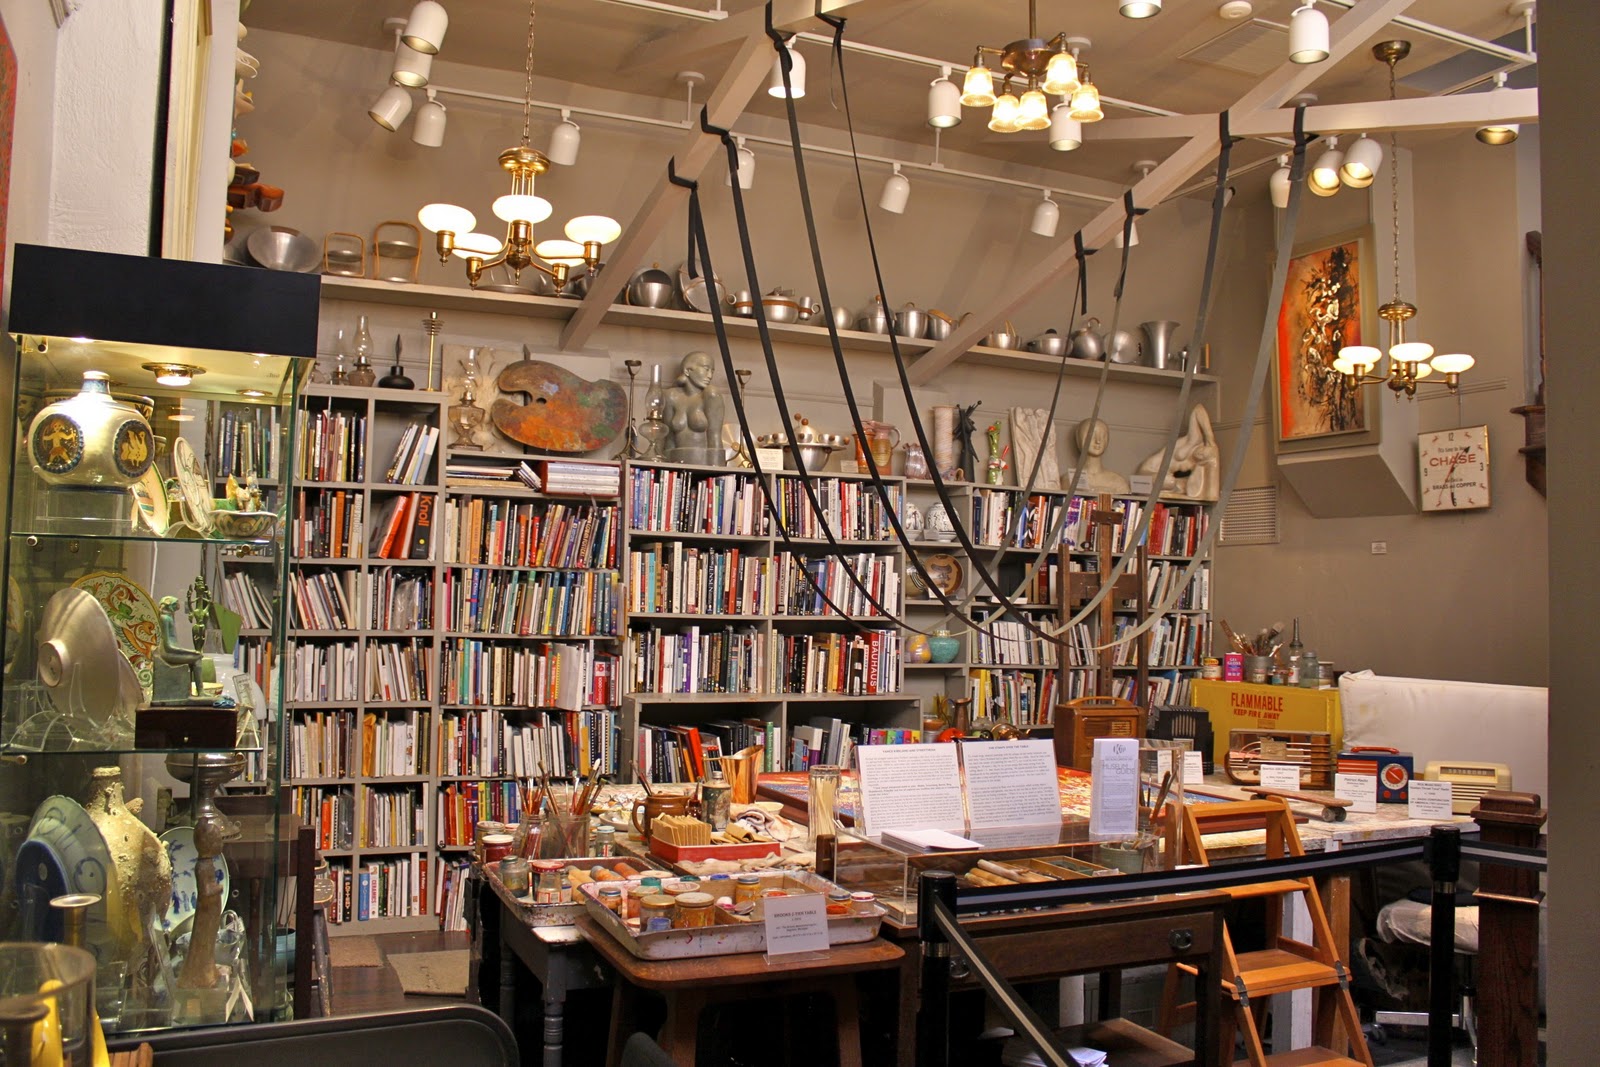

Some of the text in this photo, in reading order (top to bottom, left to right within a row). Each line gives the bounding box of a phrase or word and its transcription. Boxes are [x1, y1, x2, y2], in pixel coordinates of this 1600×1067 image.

[1448, 432, 1454, 442] 12
[1429, 453, 1477, 467] CHASE
[1480, 462, 1484, 472] 3
[418, 495, 432, 527] Knoll
[870, 640, 878, 687] BAUHAUS
[1231, 692, 1284, 712] FLAMMABLE
[1248, 710, 1261, 718] FIRE
